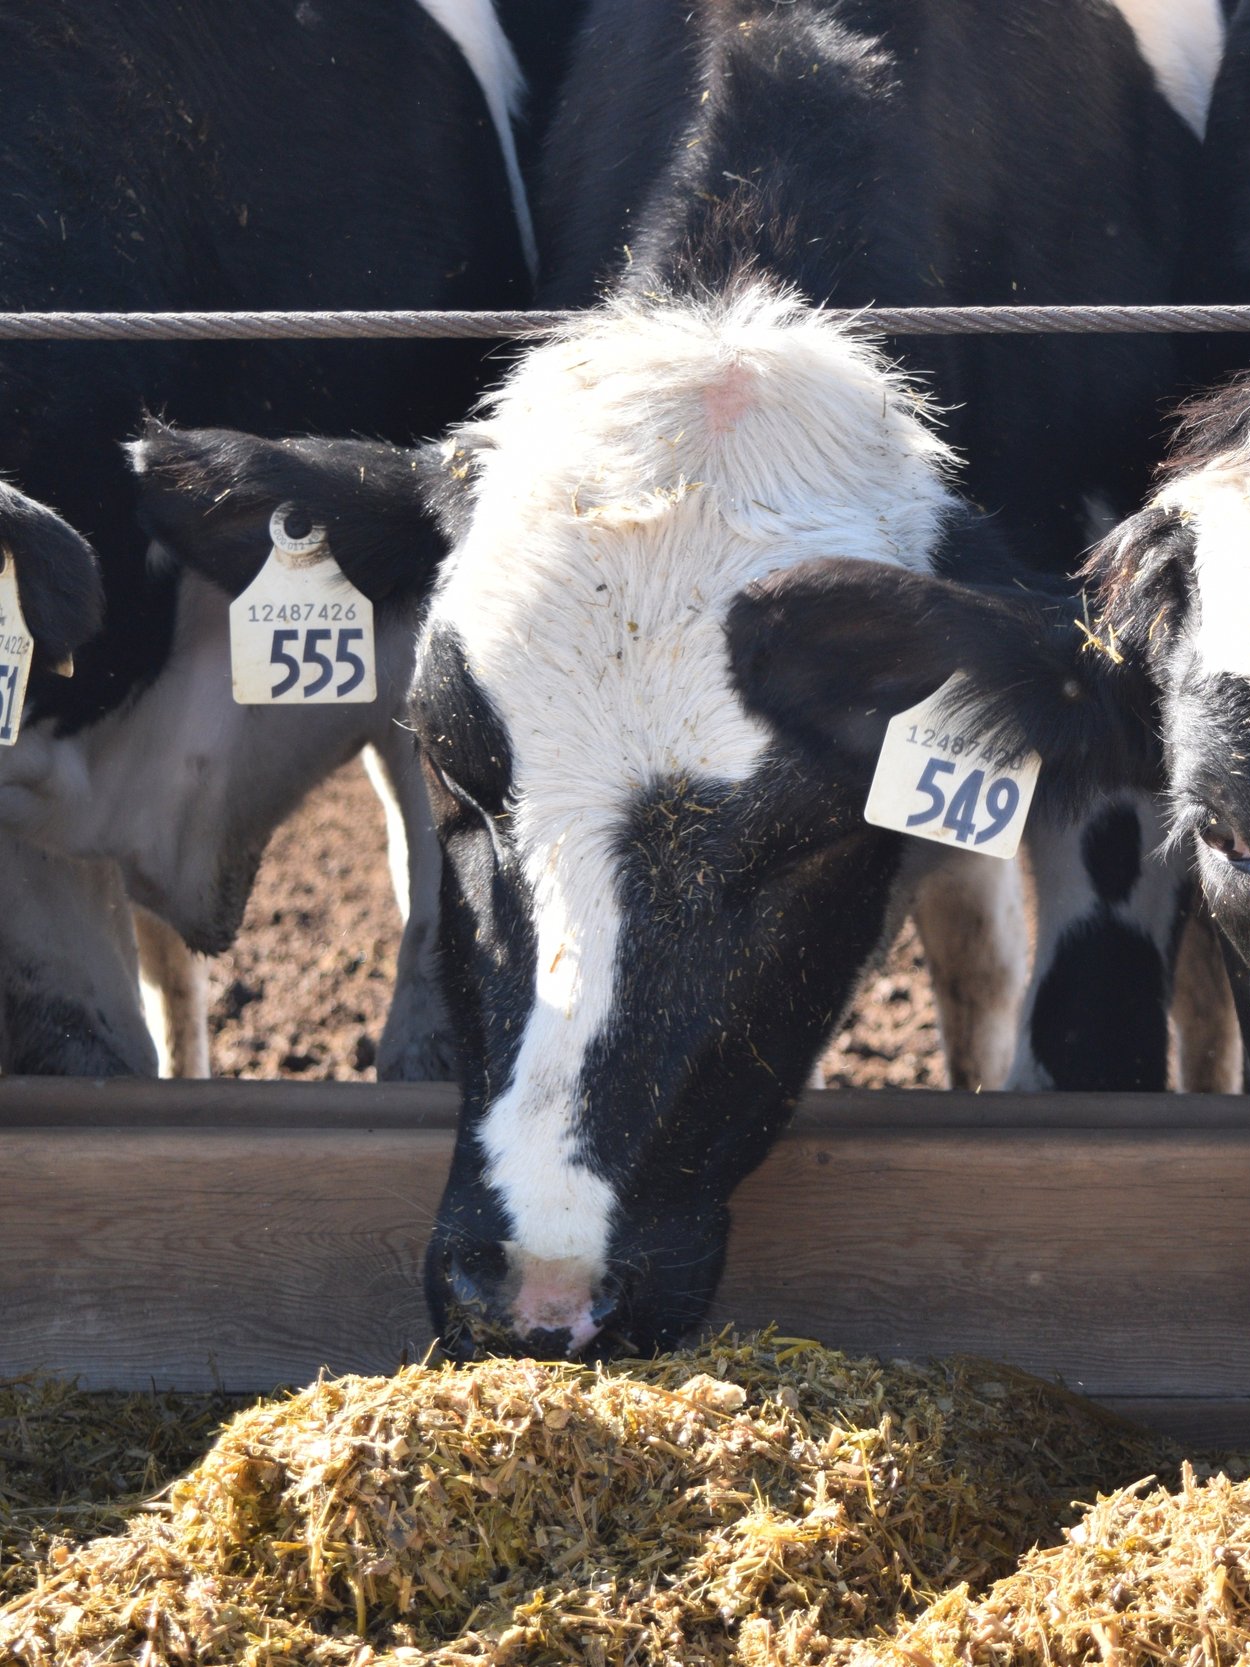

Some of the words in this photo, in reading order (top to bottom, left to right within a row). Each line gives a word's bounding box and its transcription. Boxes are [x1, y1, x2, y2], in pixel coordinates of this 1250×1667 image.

[248, 603, 356, 622] 12487426
[270, 628, 365, 699] 555
[905, 757, 1020, 846] 549
